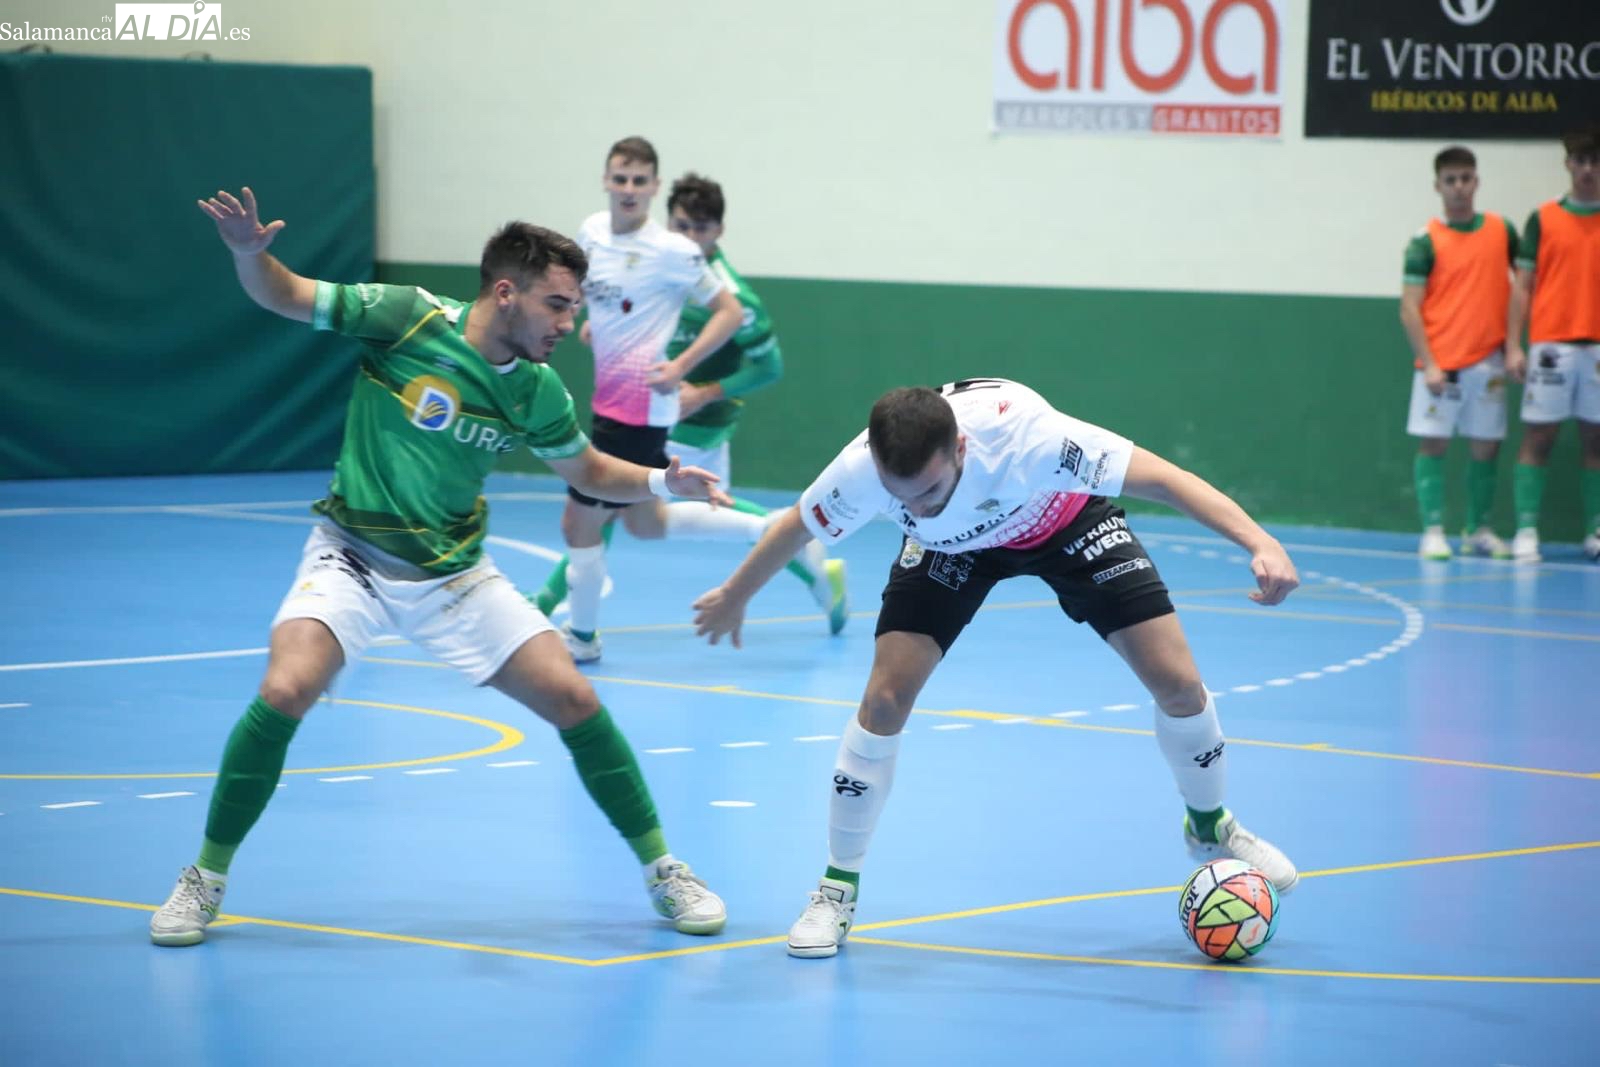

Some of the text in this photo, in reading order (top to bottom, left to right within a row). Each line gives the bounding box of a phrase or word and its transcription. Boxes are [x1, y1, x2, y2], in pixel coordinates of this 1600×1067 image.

[1471, 91, 1500, 112] DE
[1504, 91, 1558, 113] ALBA
[1154, 106, 1277, 133] GRANITOS
[1083, 530, 1133, 561] IVECO
